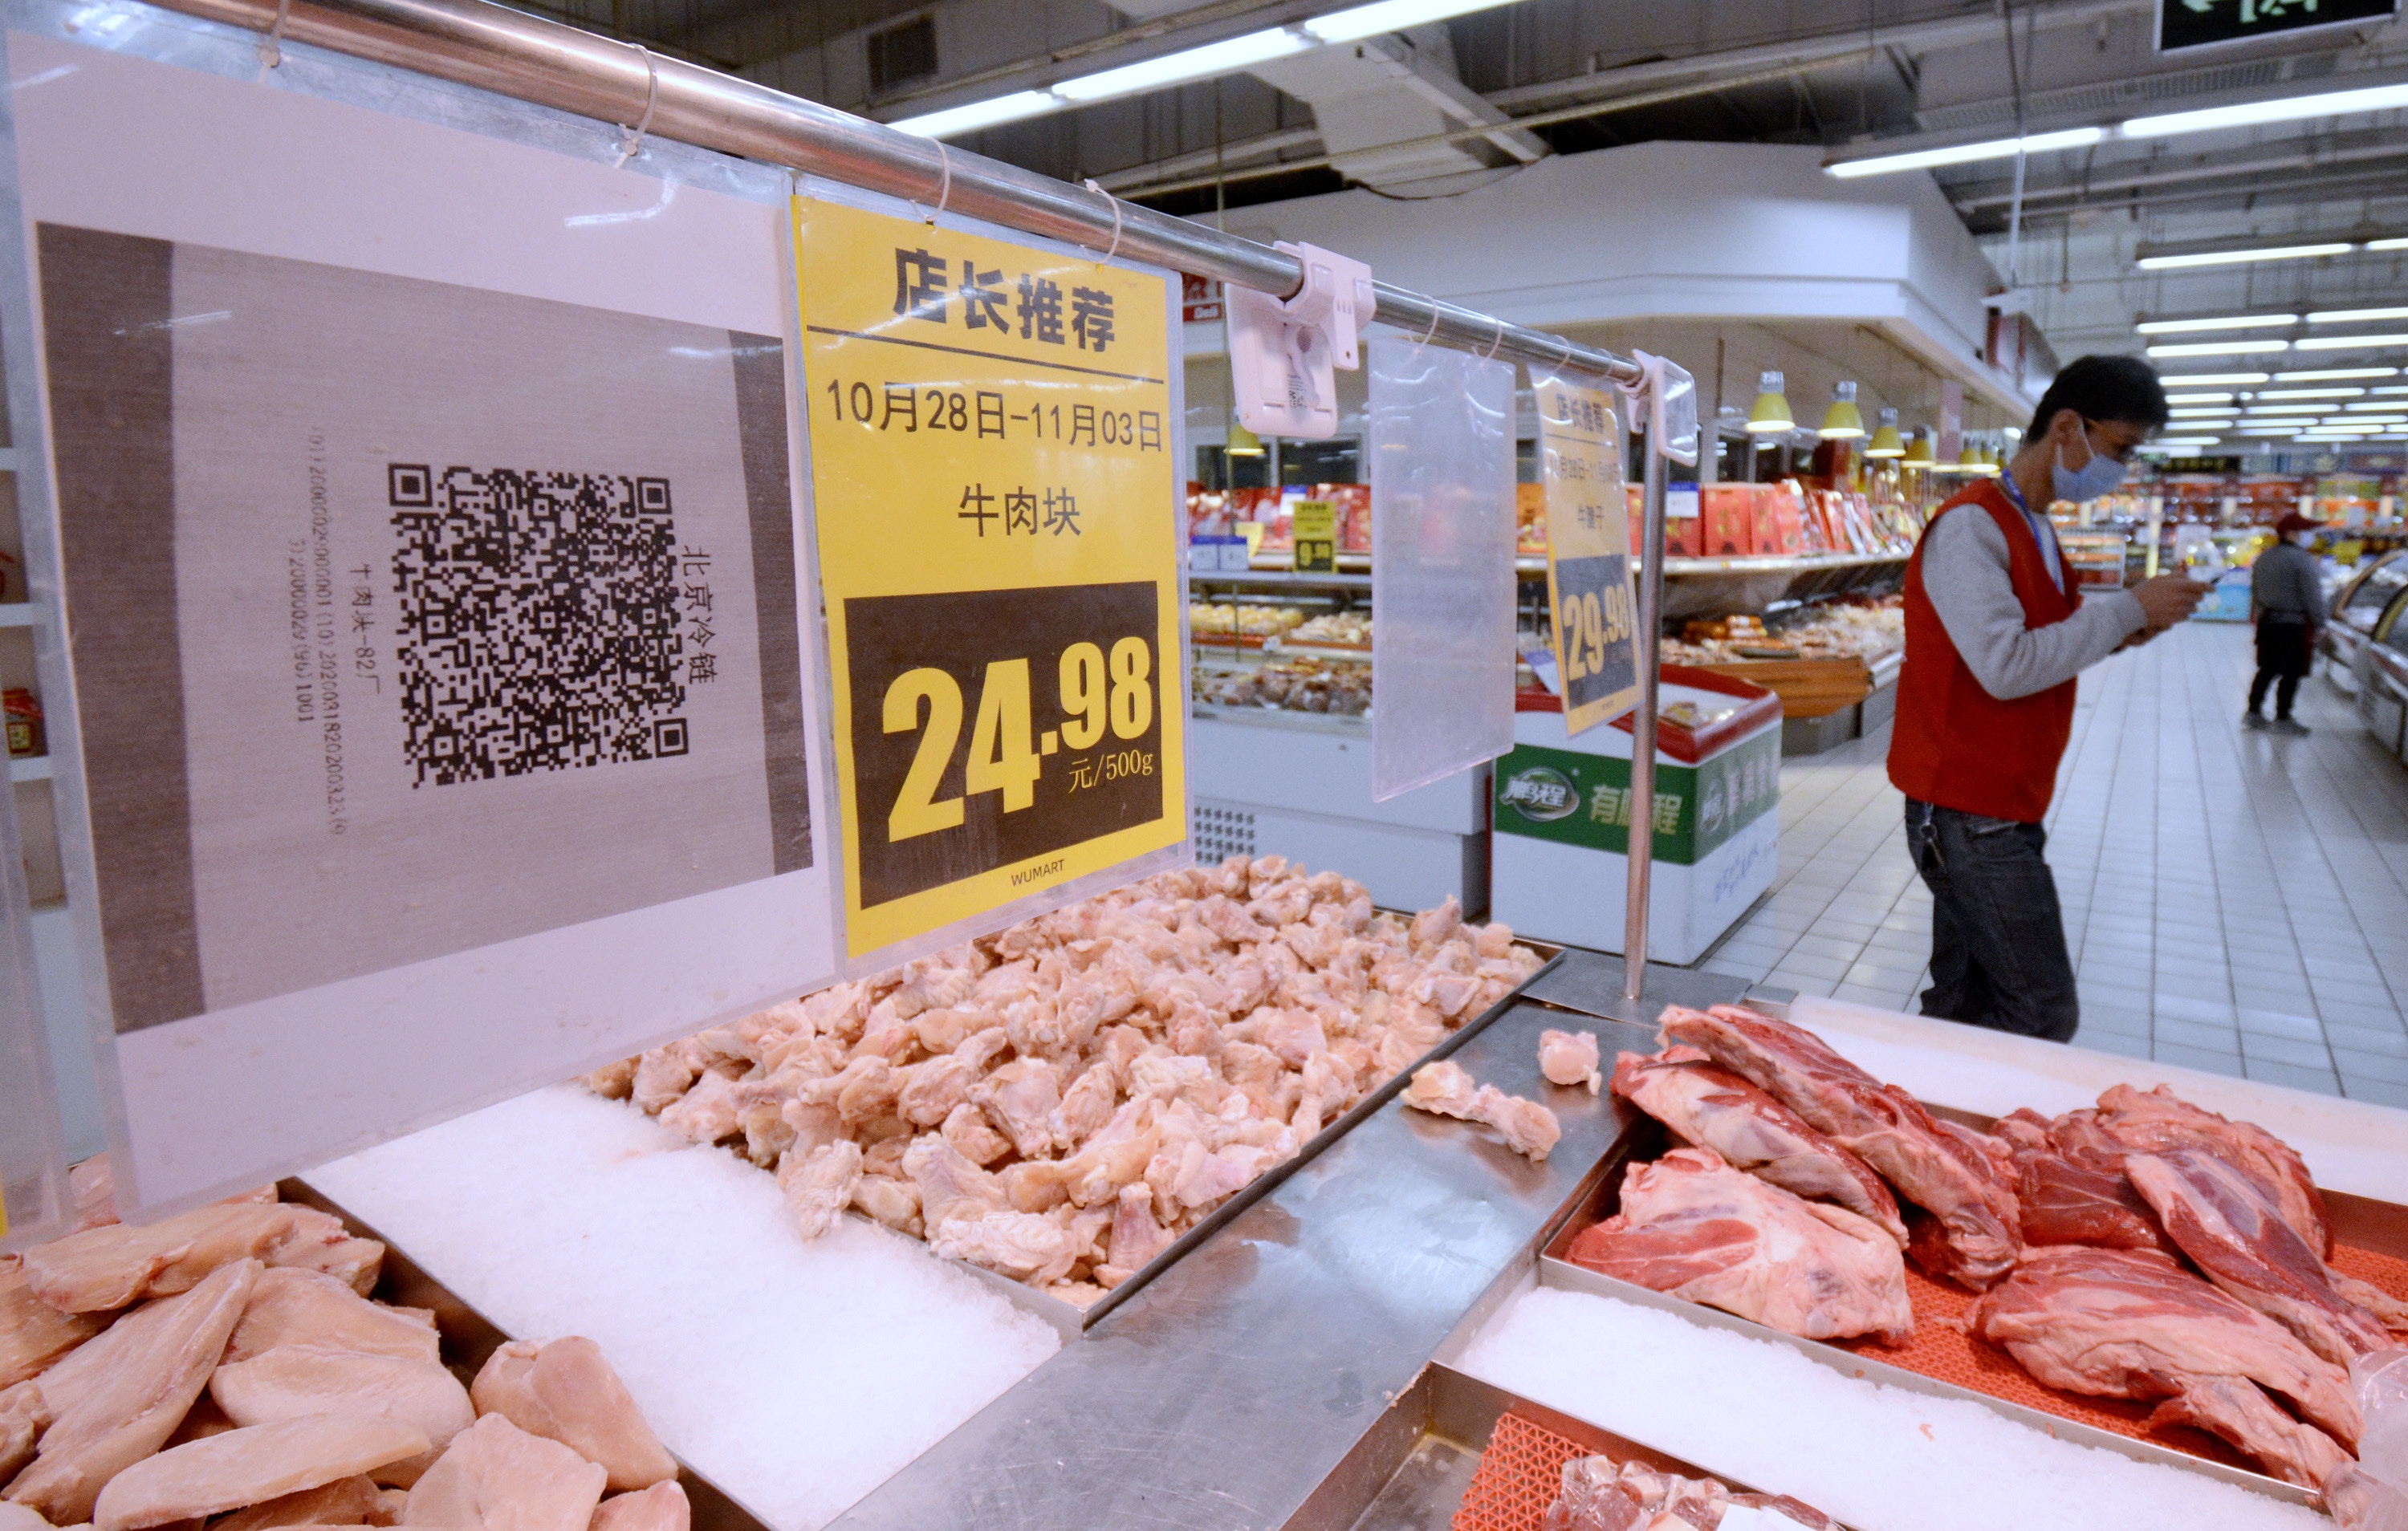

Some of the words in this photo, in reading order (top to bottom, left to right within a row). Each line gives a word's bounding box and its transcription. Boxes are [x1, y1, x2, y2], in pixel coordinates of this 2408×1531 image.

[893, 246, 1115, 352] 店长推荐
[828, 378, 1161, 452] 10月28日-11月03日
[958, 483, 1080, 537] 牛肉块
[681, 546, 718, 684] 北京冷链
[1563, 583, 1629, 680] 29.98
[882, 636, 1153, 843] 24.98
[1068, 749, 1154, 794] 元/500g
[1011, 859, 1064, 887] WUMART
